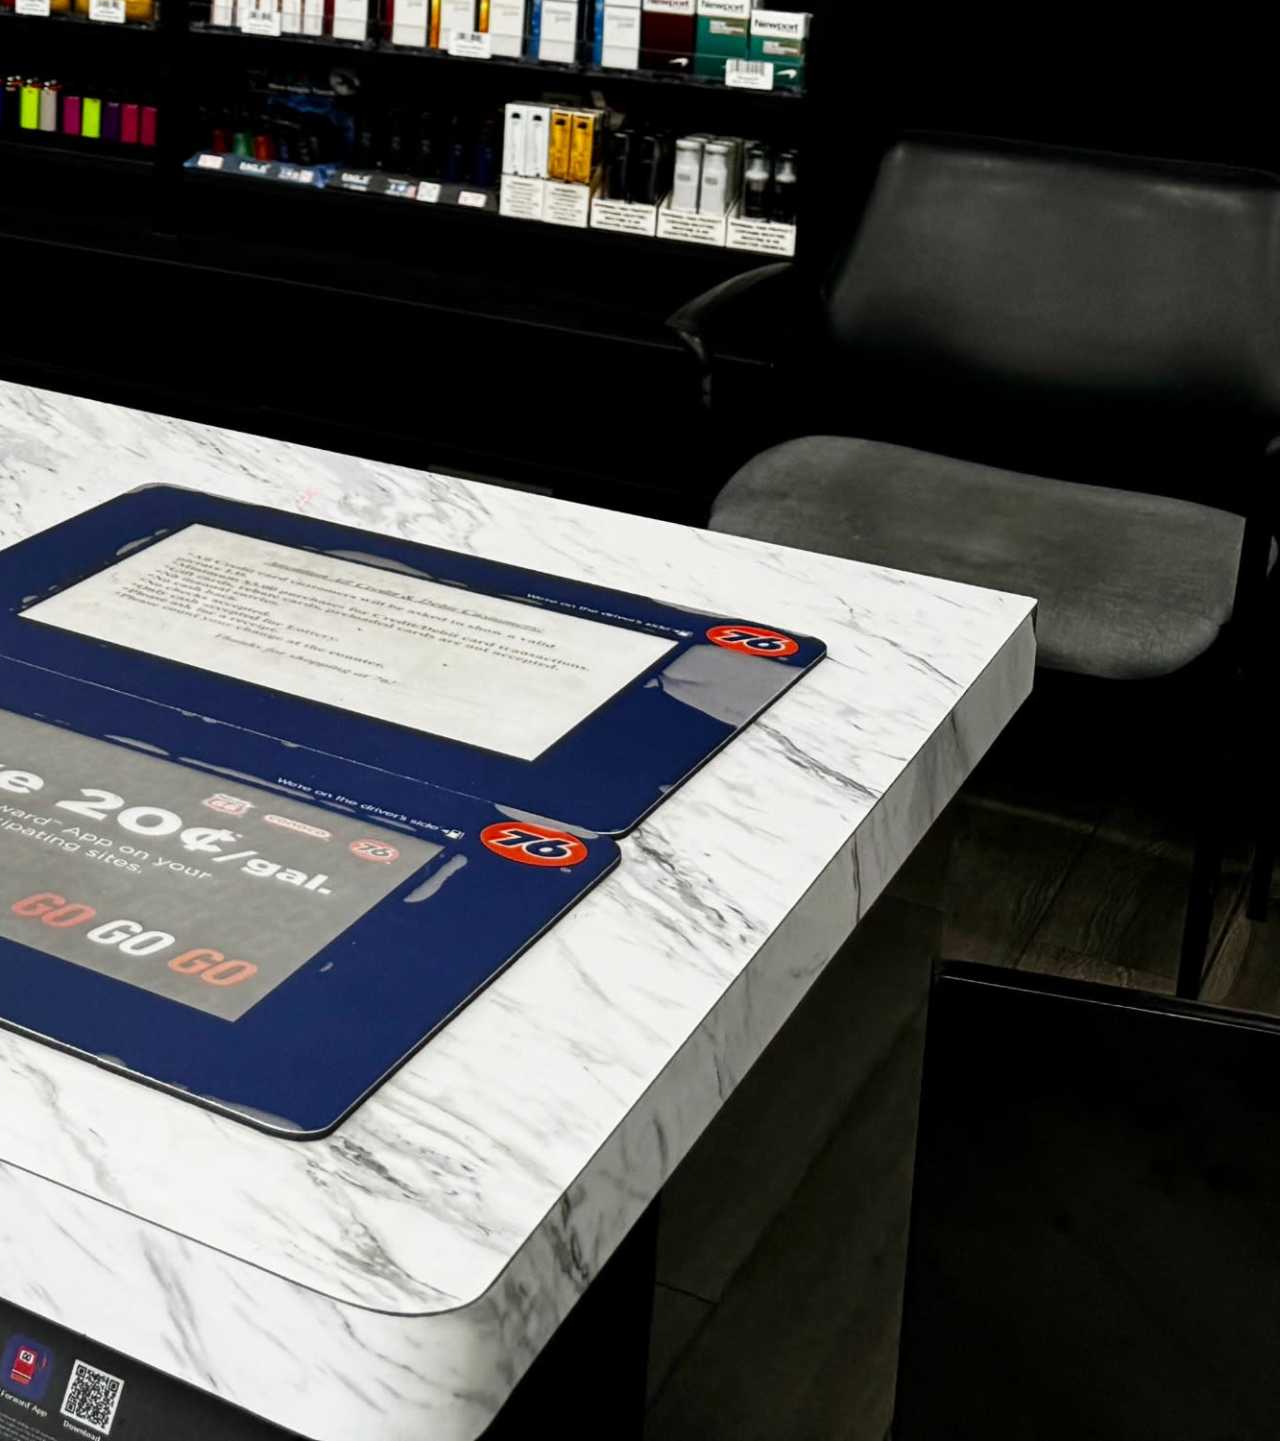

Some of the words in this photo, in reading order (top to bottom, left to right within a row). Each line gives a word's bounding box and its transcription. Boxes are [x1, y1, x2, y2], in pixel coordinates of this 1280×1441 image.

[754, 18, 799, 32] Newport
[721, 628, 792, 653] 76
[61, 823, 114, 850] App
[117, 843, 148, 860] on
[144, 853, 212, 880] your
[83, 844, 144, 875] sites.
[489, 828, 574, 860] 76
[10, 892, 96, 929] GO
[86, 918, 174, 957] GO
[168, 947, 257, 987] GO
